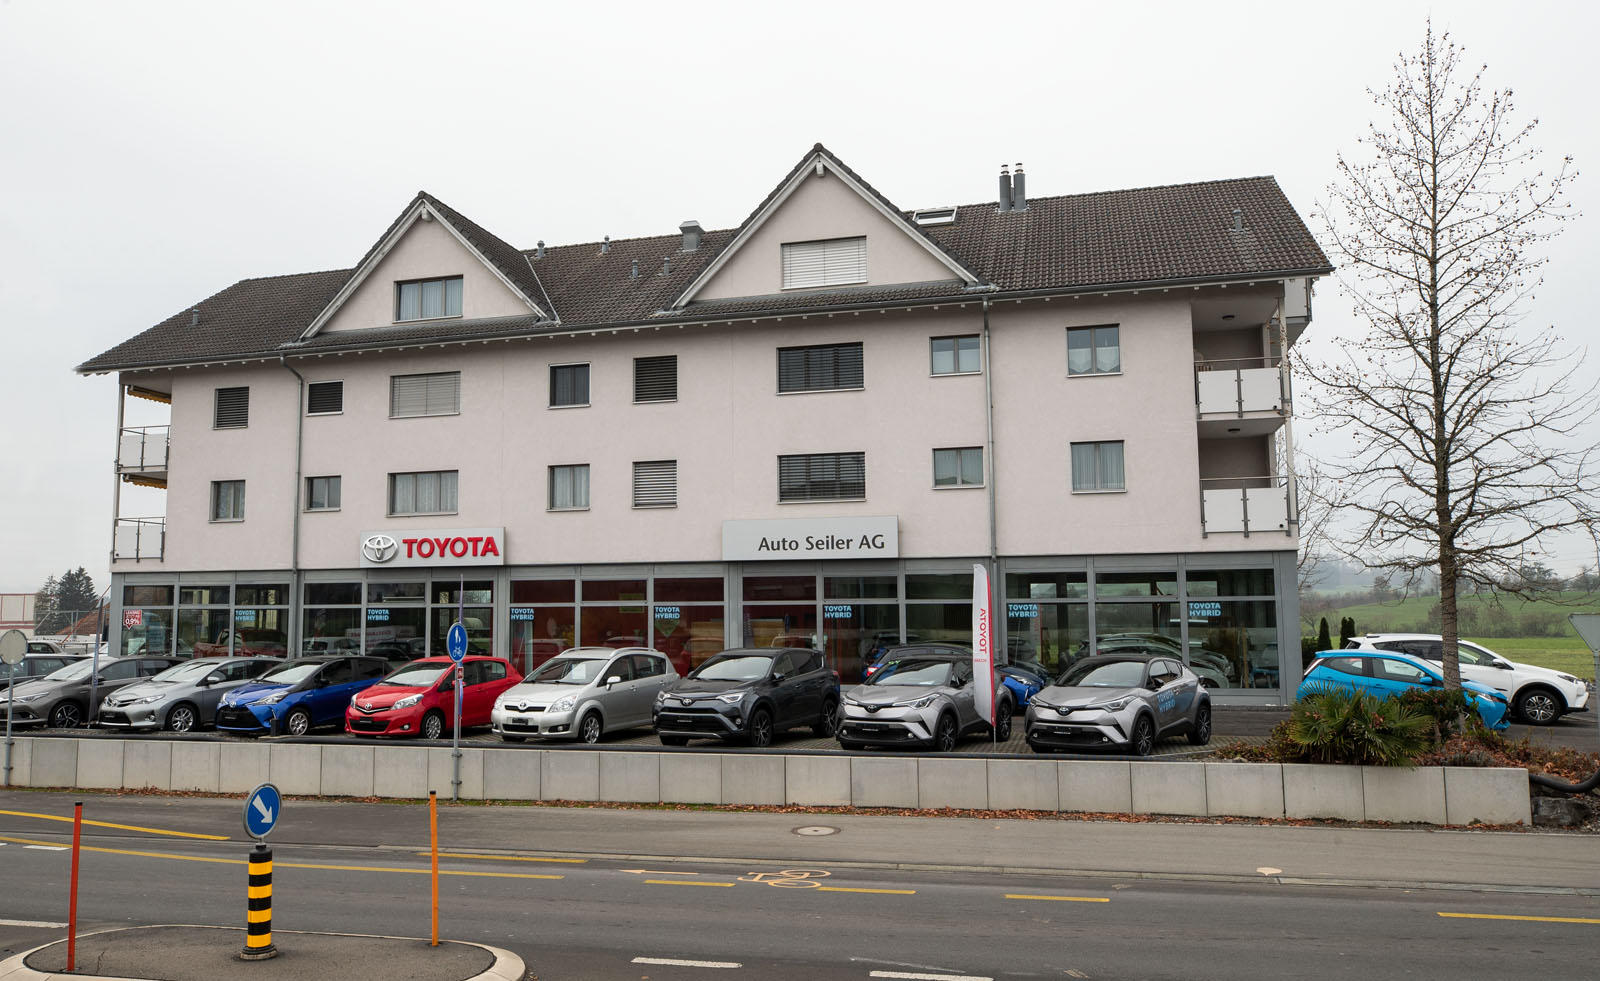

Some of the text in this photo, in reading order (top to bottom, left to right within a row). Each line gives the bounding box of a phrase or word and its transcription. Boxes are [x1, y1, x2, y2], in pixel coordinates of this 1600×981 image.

[402, 536, 499, 558] TOYOTA
[758, 534, 885, 551] Auto Seiler AG
